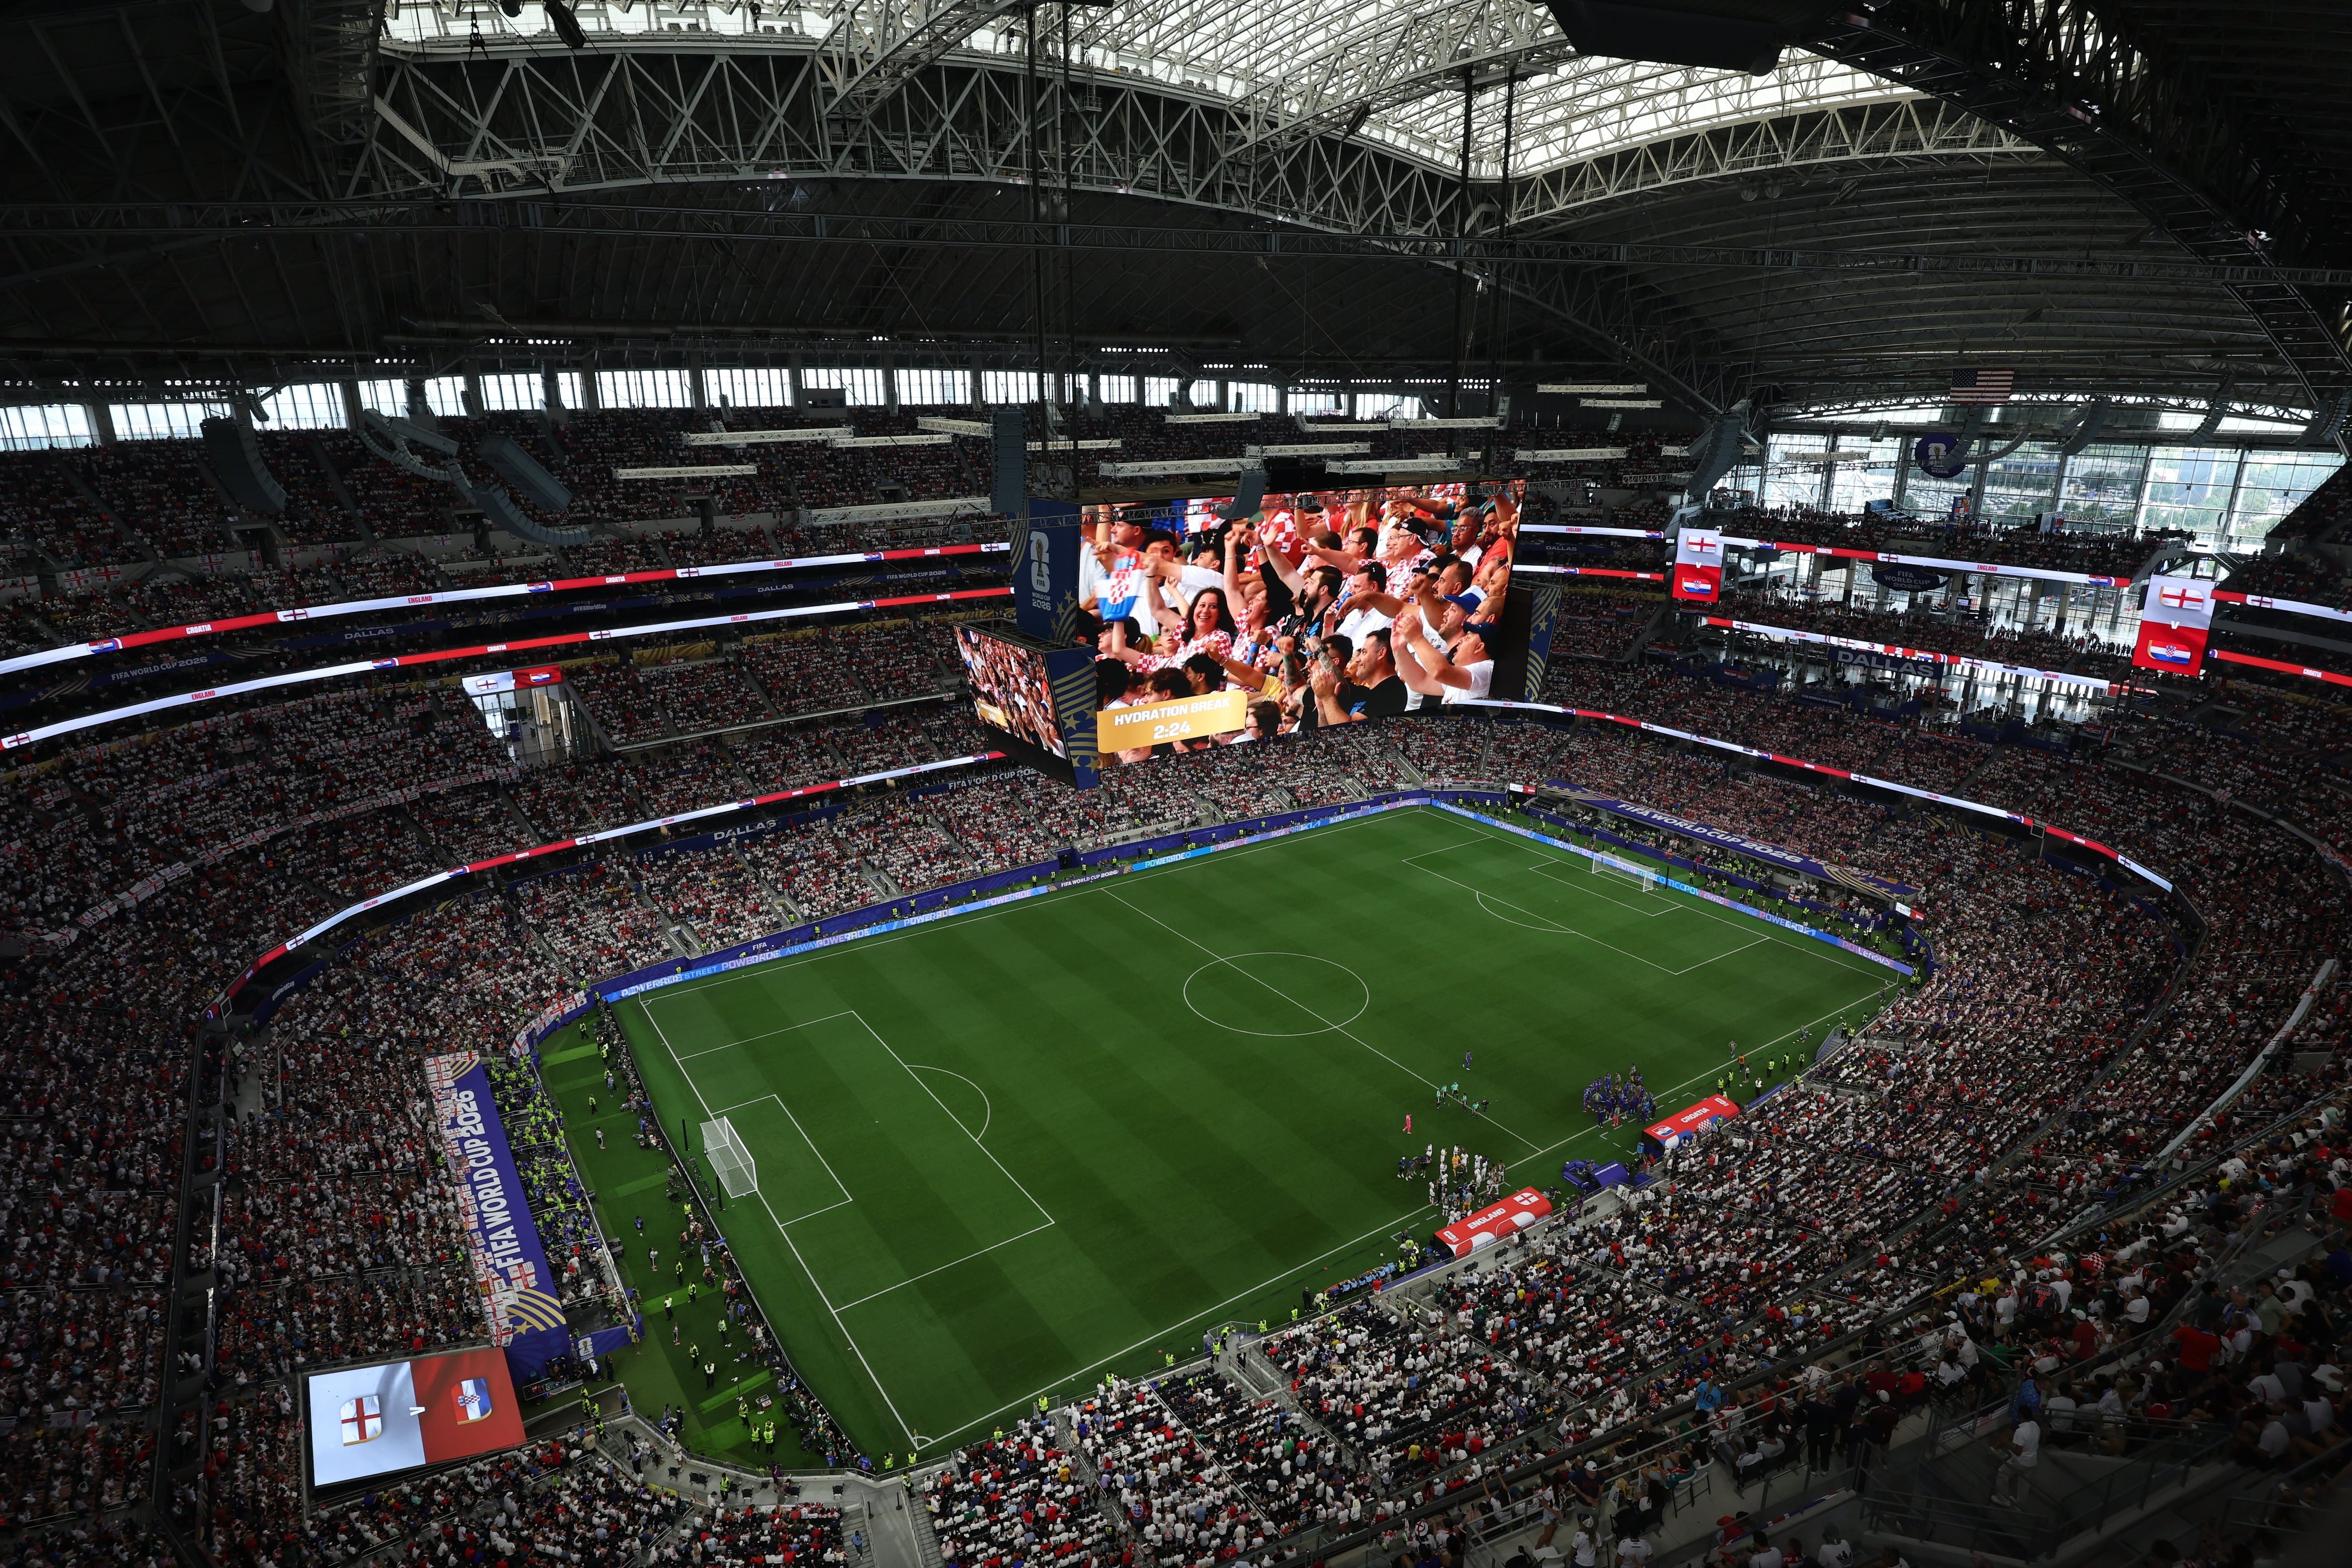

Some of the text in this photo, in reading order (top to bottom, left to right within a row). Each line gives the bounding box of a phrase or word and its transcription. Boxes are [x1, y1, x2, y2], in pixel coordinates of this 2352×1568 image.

[1884, 574, 1913, 584] WORLD
[757, 584, 794, 593] DALLAS
[1032, 592, 1044, 600] WORLD
[1032, 598, 1051, 611] 2026
[186, 624, 212, 635] CROATIA
[2171, 621, 2180, 629] V
[344, 628, 394, 640] DALLAS
[130, 666, 160, 677] WORLD
[177, 656, 208, 668] 2026
[1838, 650, 1934, 677] DALLAS
[2303, 668, 2322, 678] CROATIA
[191, 691, 215, 700] ENGLAND
[1114, 696, 1231, 726] HYDRATION BREAK
[2166, 716, 2196, 727] DALLAS
[1153, 720, 1191, 740] 2:24
[968, 774, 998, 785] WORD
[1000, 769, 1016, 781] CUP
[714, 819, 777, 841] DALLAS
[1617, 804, 1804, 863] FIFA WORLD CUP 2026
[2074, 836, 2085, 844] CROATIA
[1554, 839, 1594, 858] POWERADE
[1145, 852, 1185, 868] POWERADE
[1101, 870, 1117, 878] 2026
[364, 899, 378, 908] ENGLAND
[985, 889, 1032, 906] POWERADE
[903, 908, 954, 927] POWERADE
[753, 942, 767, 950] FIFA
[1858, 947, 1890, 966] Lenovo
[457, 1089, 485, 1138] 2026
[1680, 1107, 1710, 1123] CROATIA
[469, 1140, 494, 1168] CUP
[2235, 1168, 2240, 1178] 5
[473, 1167, 509, 1229] WORLD
[1467, 1208, 1507, 1230] ENGLAND
[492, 1225, 524, 1269] FIFA
[2037, 1295, 2047, 1307] 7
